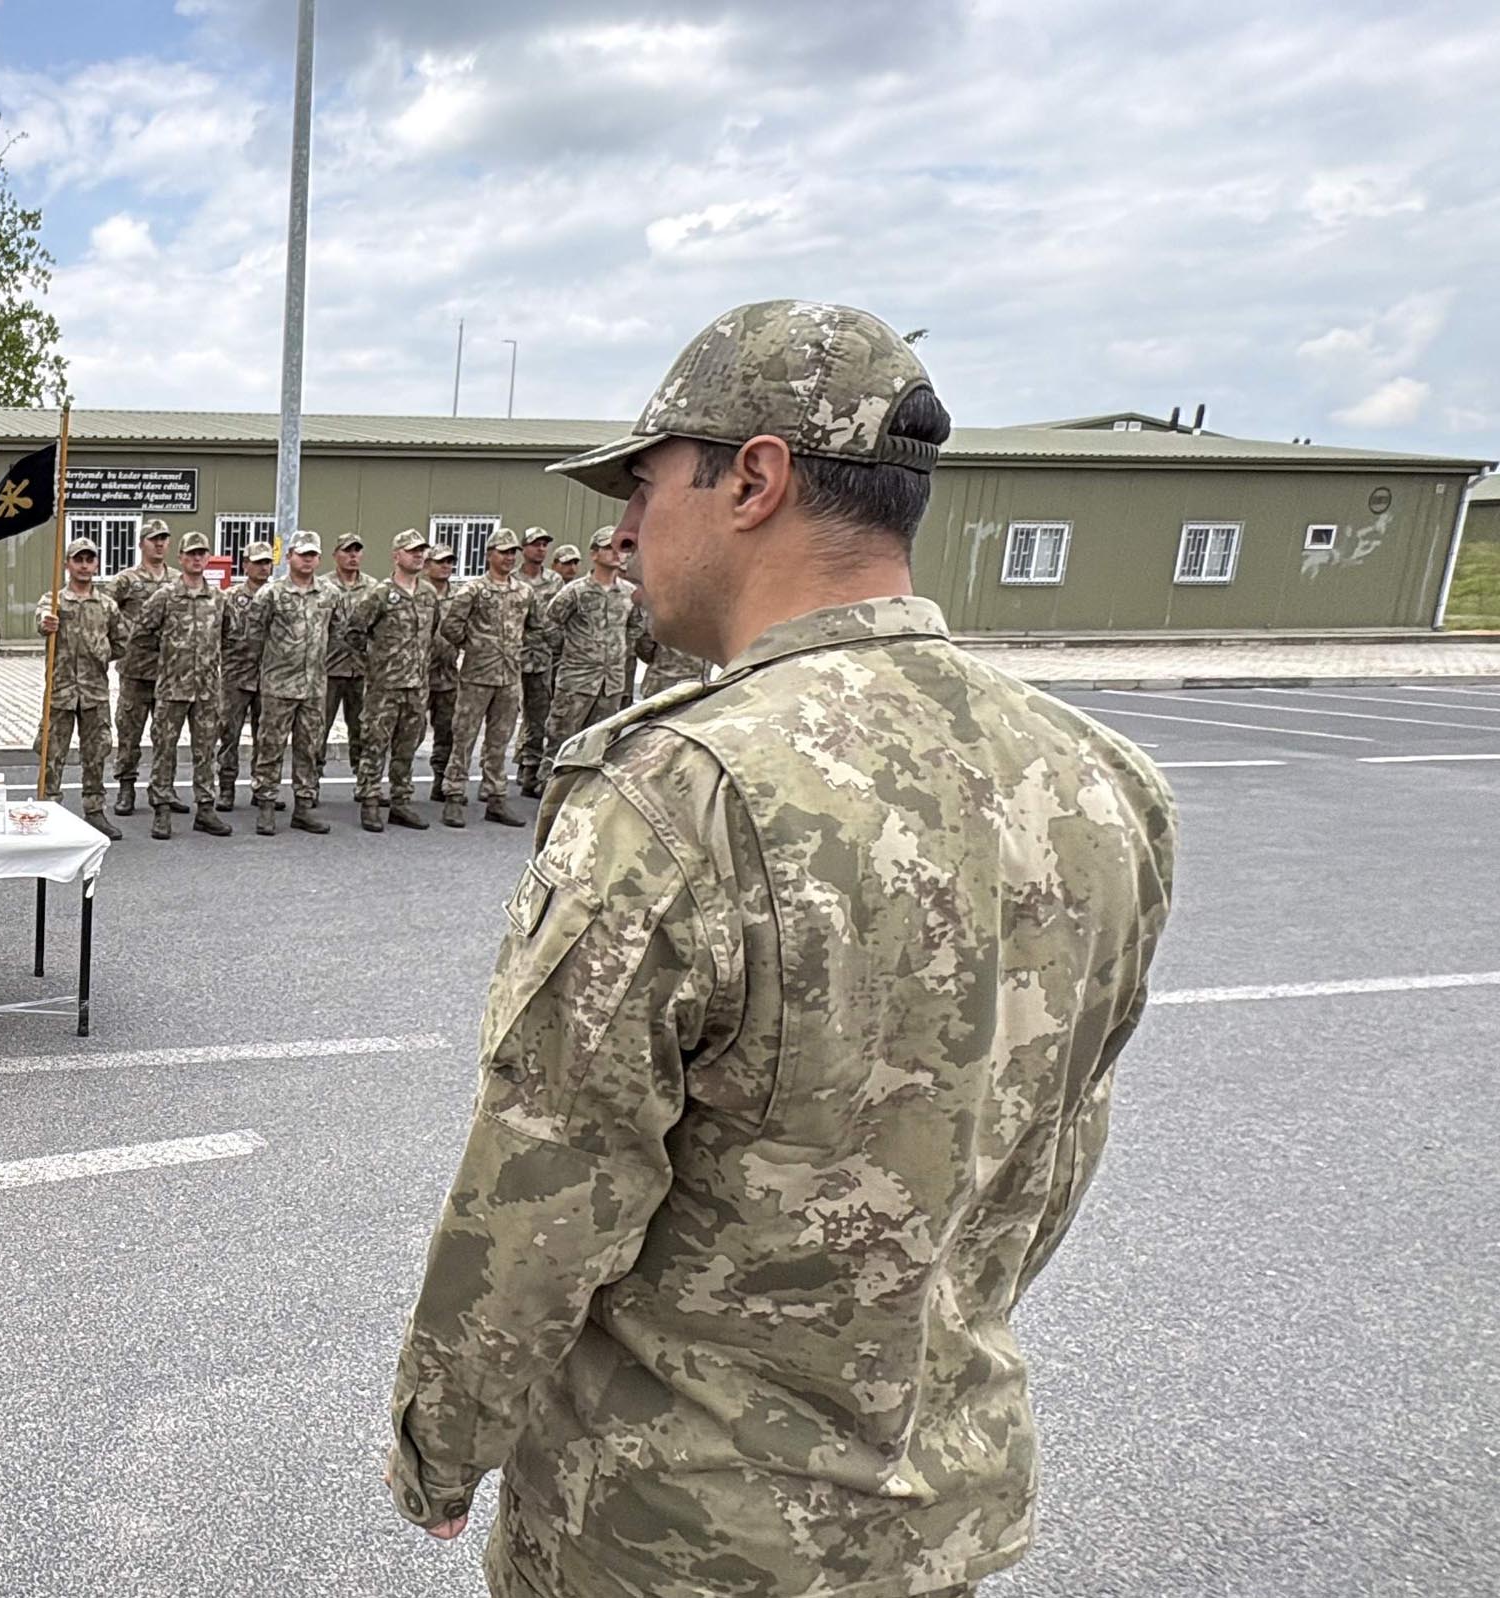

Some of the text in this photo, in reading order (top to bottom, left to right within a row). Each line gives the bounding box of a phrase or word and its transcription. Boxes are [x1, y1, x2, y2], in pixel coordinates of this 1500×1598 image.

[107, 471, 117, 479] bu
[118, 471, 141, 480] kadar
[142, 472, 182, 480] mükemmel
[75, 481, 99, 489] kadar
[101, 481, 142, 490] mükemmel
[142, 482, 163, 490] idare
[163, 482, 190, 492] edilmiş
[143, 492, 173, 502] Ağustos
[174, 492, 192, 501] 1922
